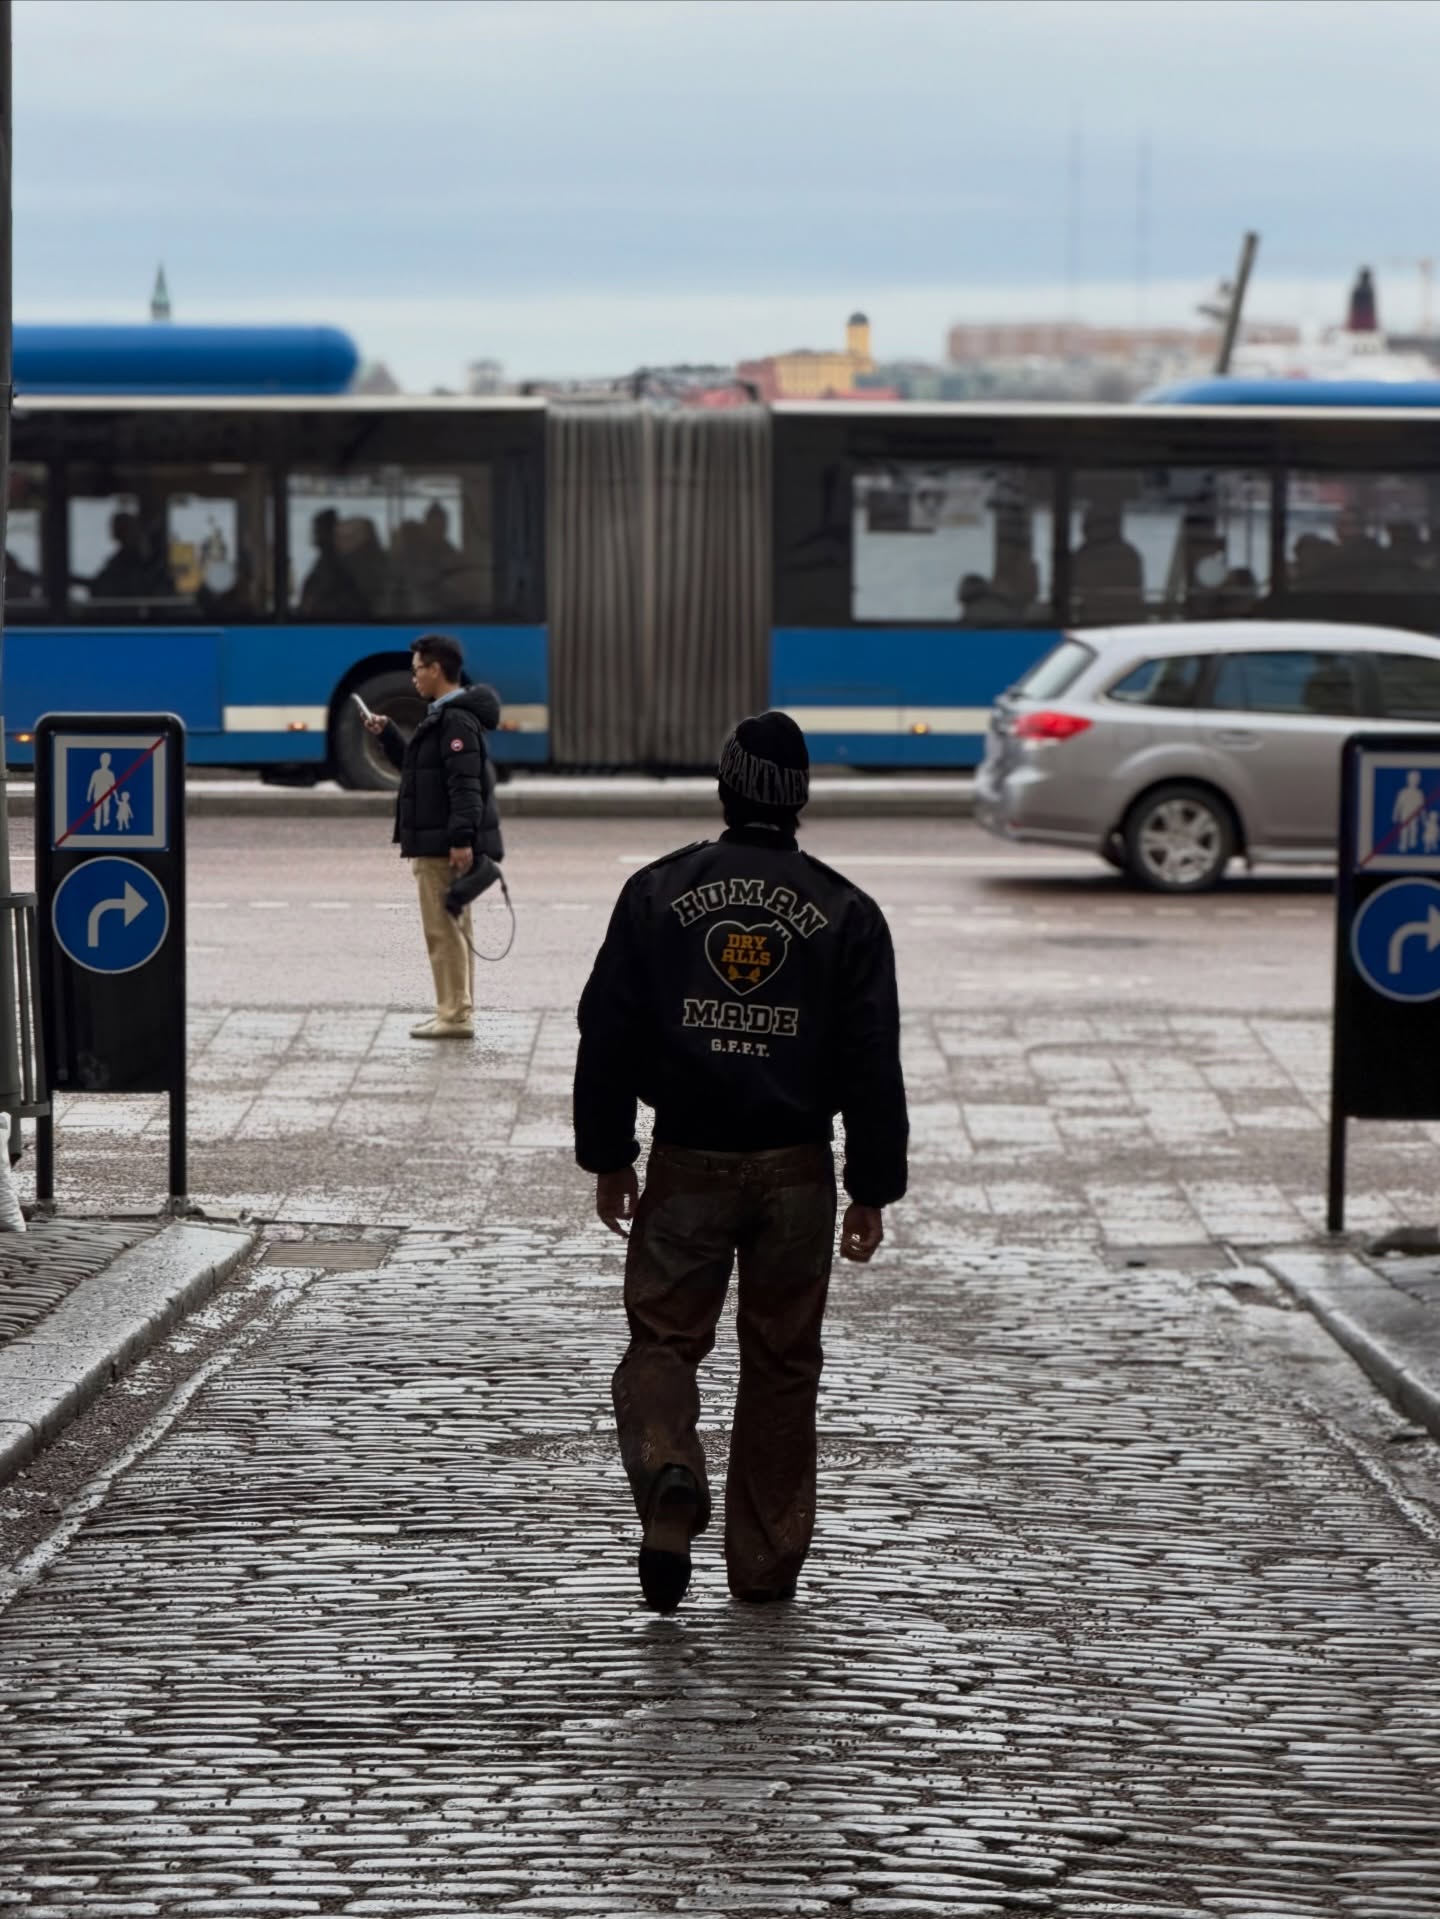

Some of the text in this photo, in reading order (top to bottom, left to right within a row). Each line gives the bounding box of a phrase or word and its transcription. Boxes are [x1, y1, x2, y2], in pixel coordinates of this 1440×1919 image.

[671, 878, 828, 938] HUMAN
[727, 934, 767, 950] DRY
[721, 950, 771, 966] ALLS
[682, 999, 799, 1036] MADE
[711, 1039, 770, 1057] G.F.F.T.
